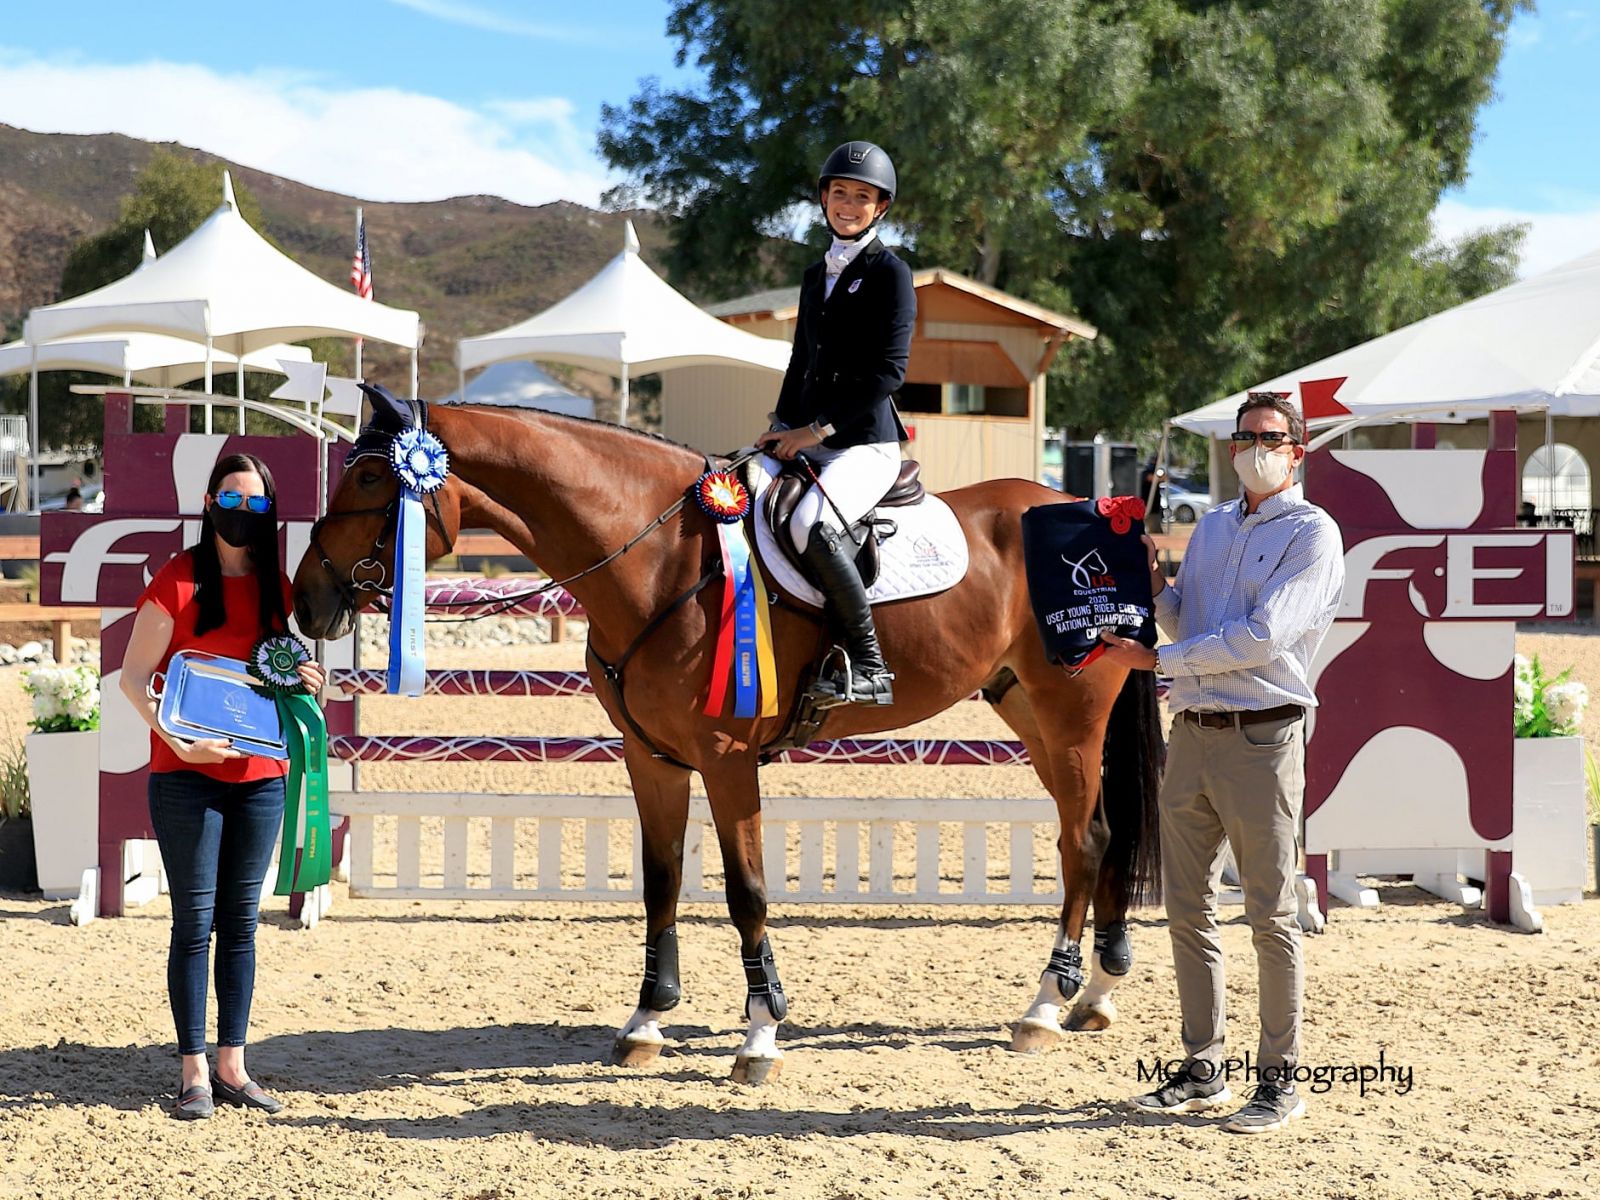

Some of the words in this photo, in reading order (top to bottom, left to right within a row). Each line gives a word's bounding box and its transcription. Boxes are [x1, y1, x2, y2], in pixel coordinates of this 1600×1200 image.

[1092, 575, 1115, 587] US
[1334, 533, 1574, 619] FEI
[1073, 587, 1116, 595] EQUESTRIAN
[1088, 595, 1108, 604] 2020
[1046, 610, 1064, 624] USEF
[1067, 605, 1091, 617] YOUNG
[1094, 603, 1116, 613] RIDER
[1056, 617, 1092, 633] NATIONAL
[1094, 613, 1143, 627] CHAMPIONSHIP
